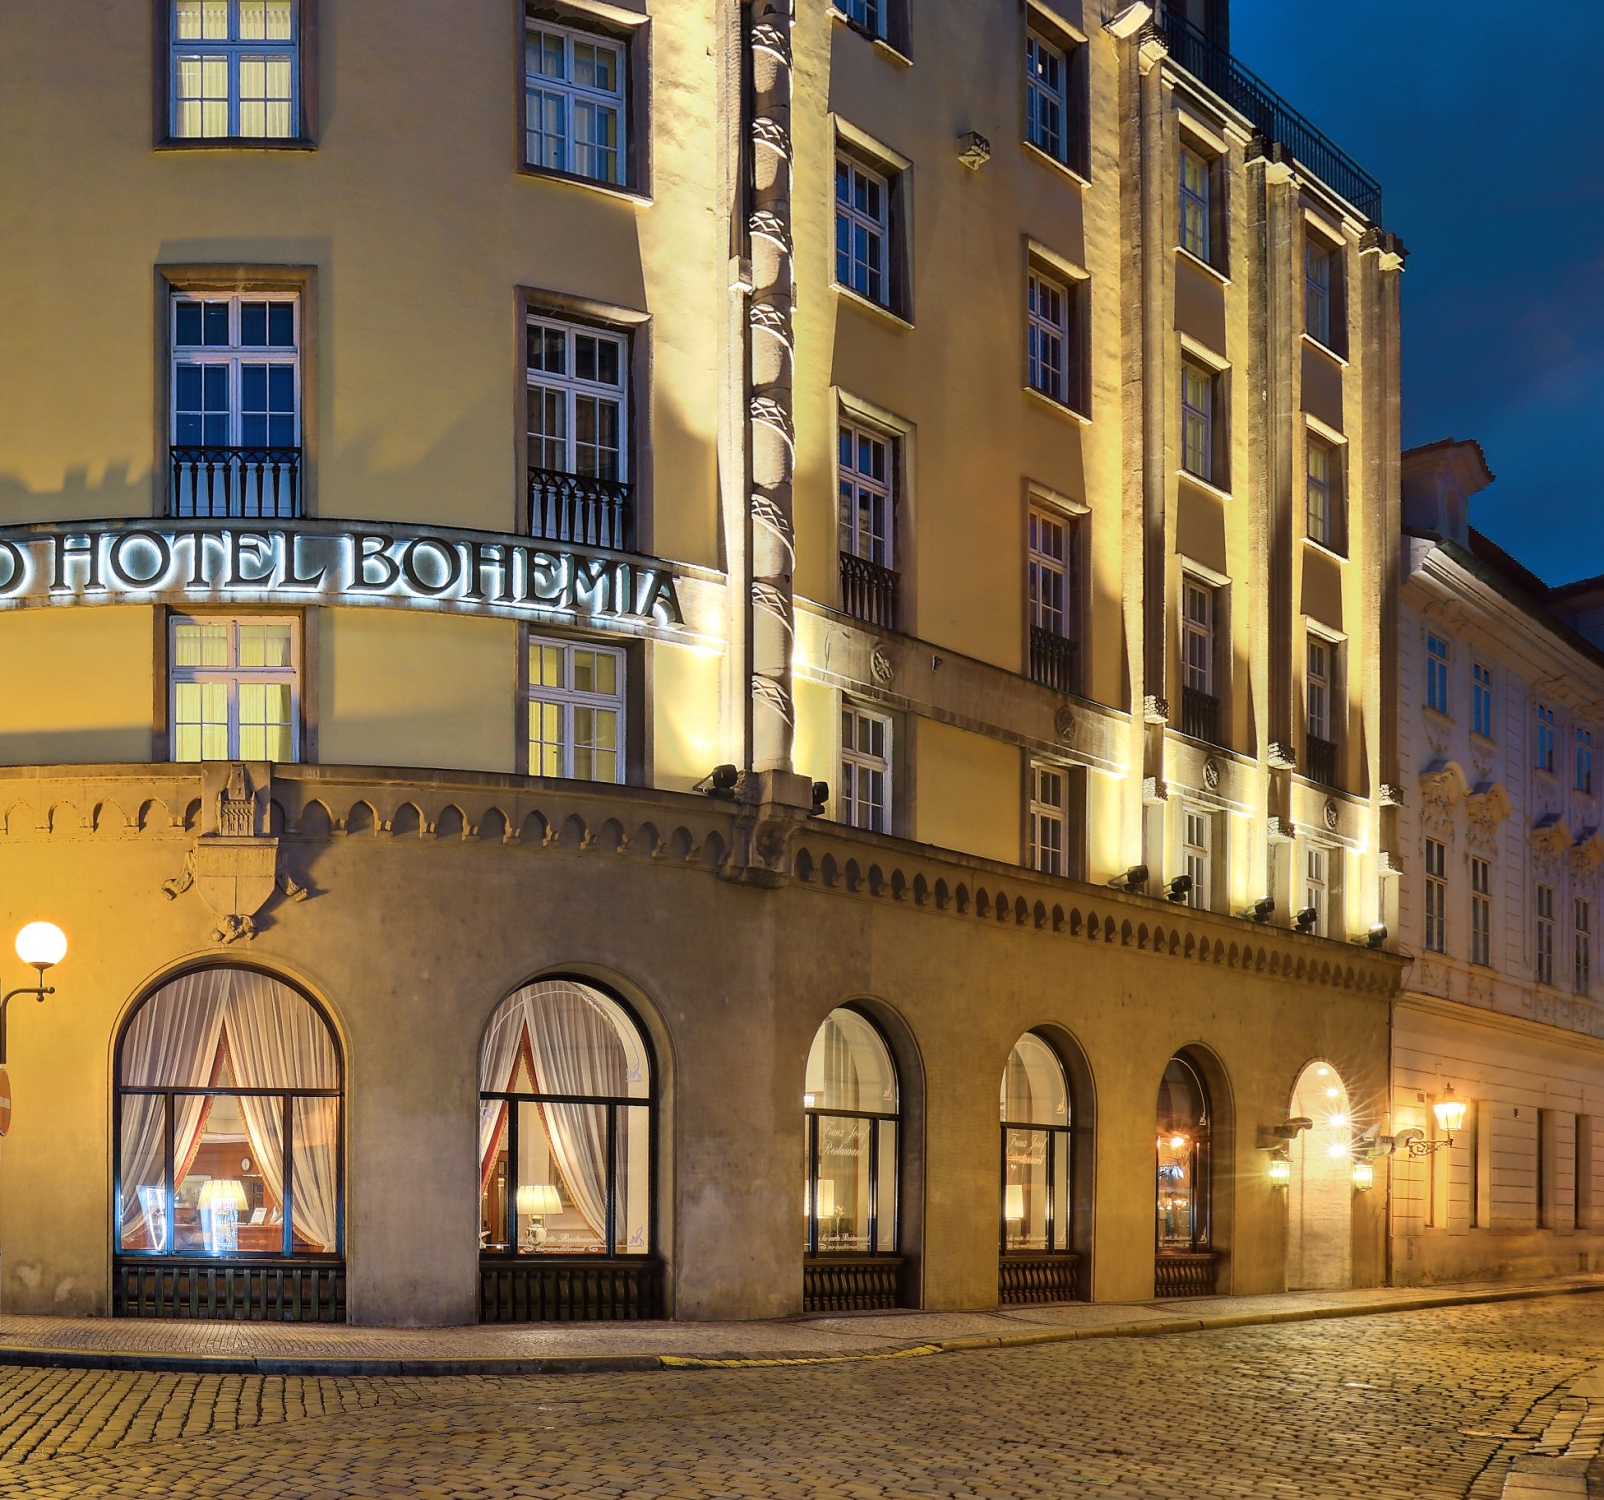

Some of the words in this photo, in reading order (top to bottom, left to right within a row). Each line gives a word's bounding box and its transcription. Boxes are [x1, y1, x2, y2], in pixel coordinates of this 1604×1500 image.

[50, 529, 327, 592] HOTEL
[347, 532, 685, 625] BOHEMIA
[823, 1140, 867, 1157] Restaurant
